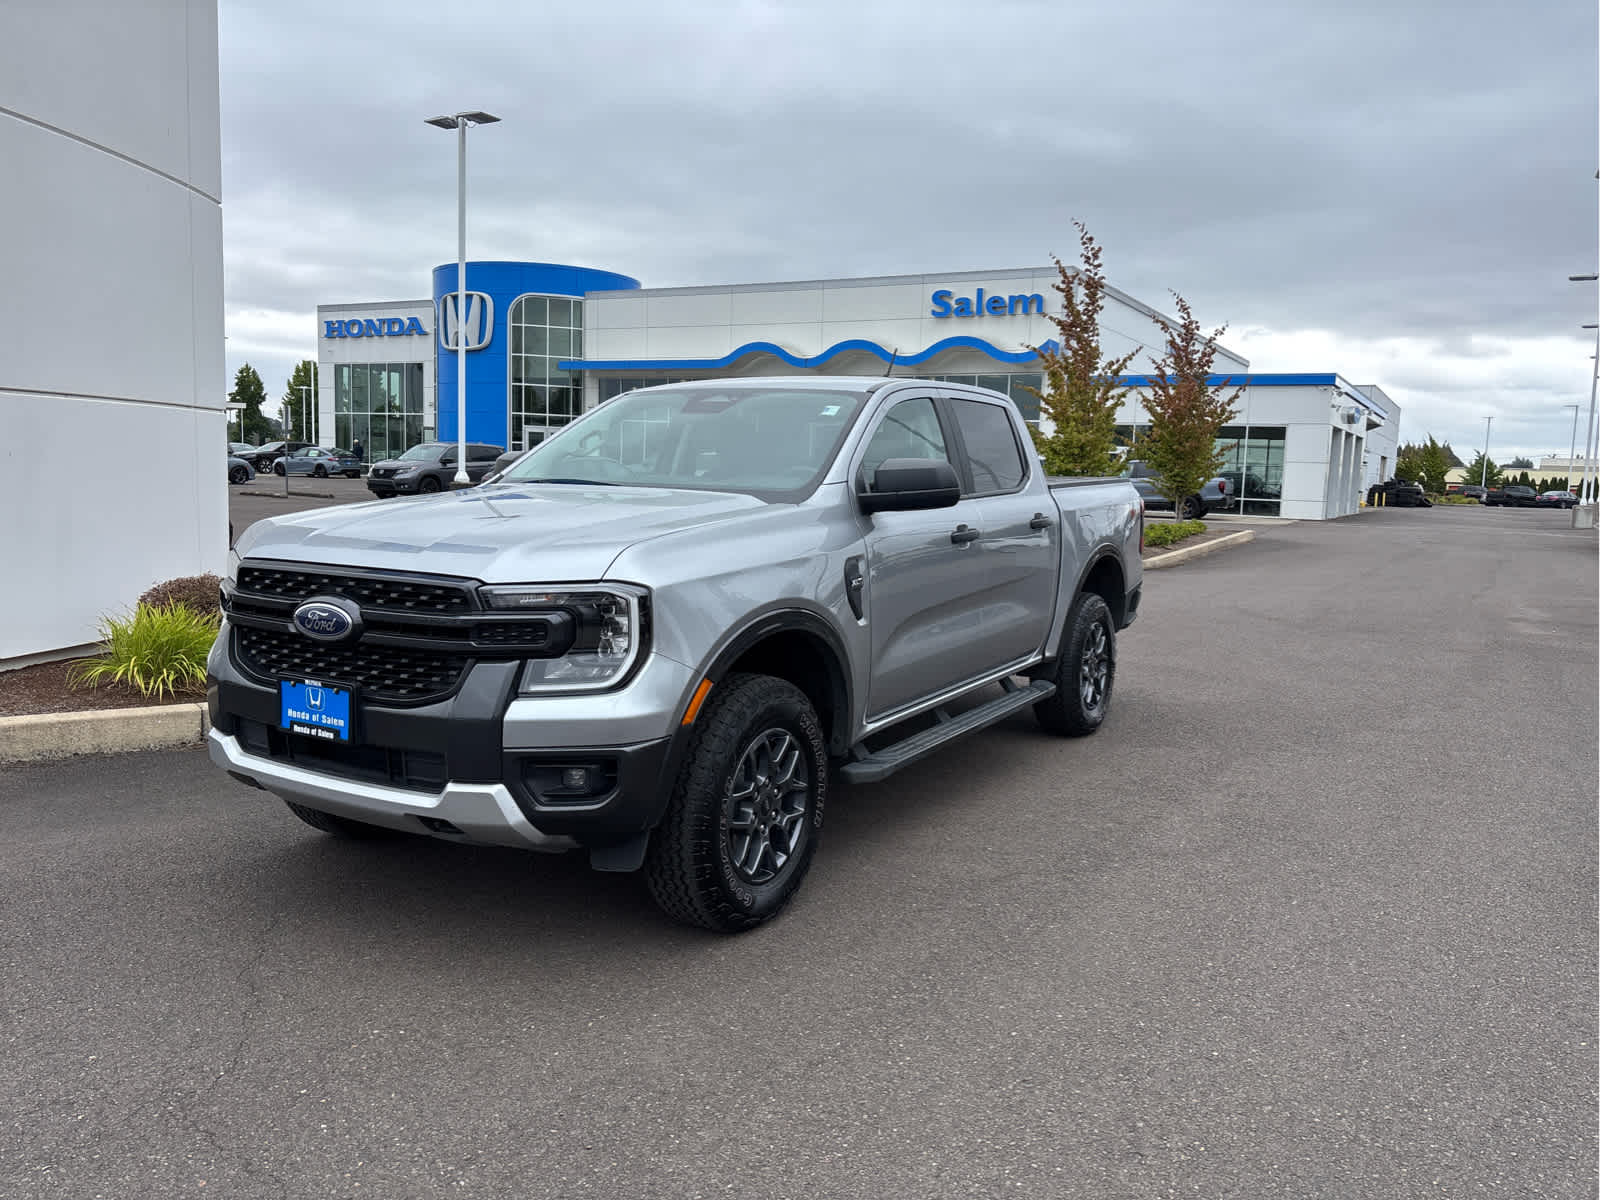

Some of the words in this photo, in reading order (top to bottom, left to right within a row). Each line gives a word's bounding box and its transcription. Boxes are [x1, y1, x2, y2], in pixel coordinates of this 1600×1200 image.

[930, 287, 1044, 318] Salem
[324, 316, 429, 338] HONDA
[304, 610, 337, 632] Ford
[287, 707, 310, 721] Honda
[312, 713, 319, 722] of
[321, 714, 345, 727] Salem
